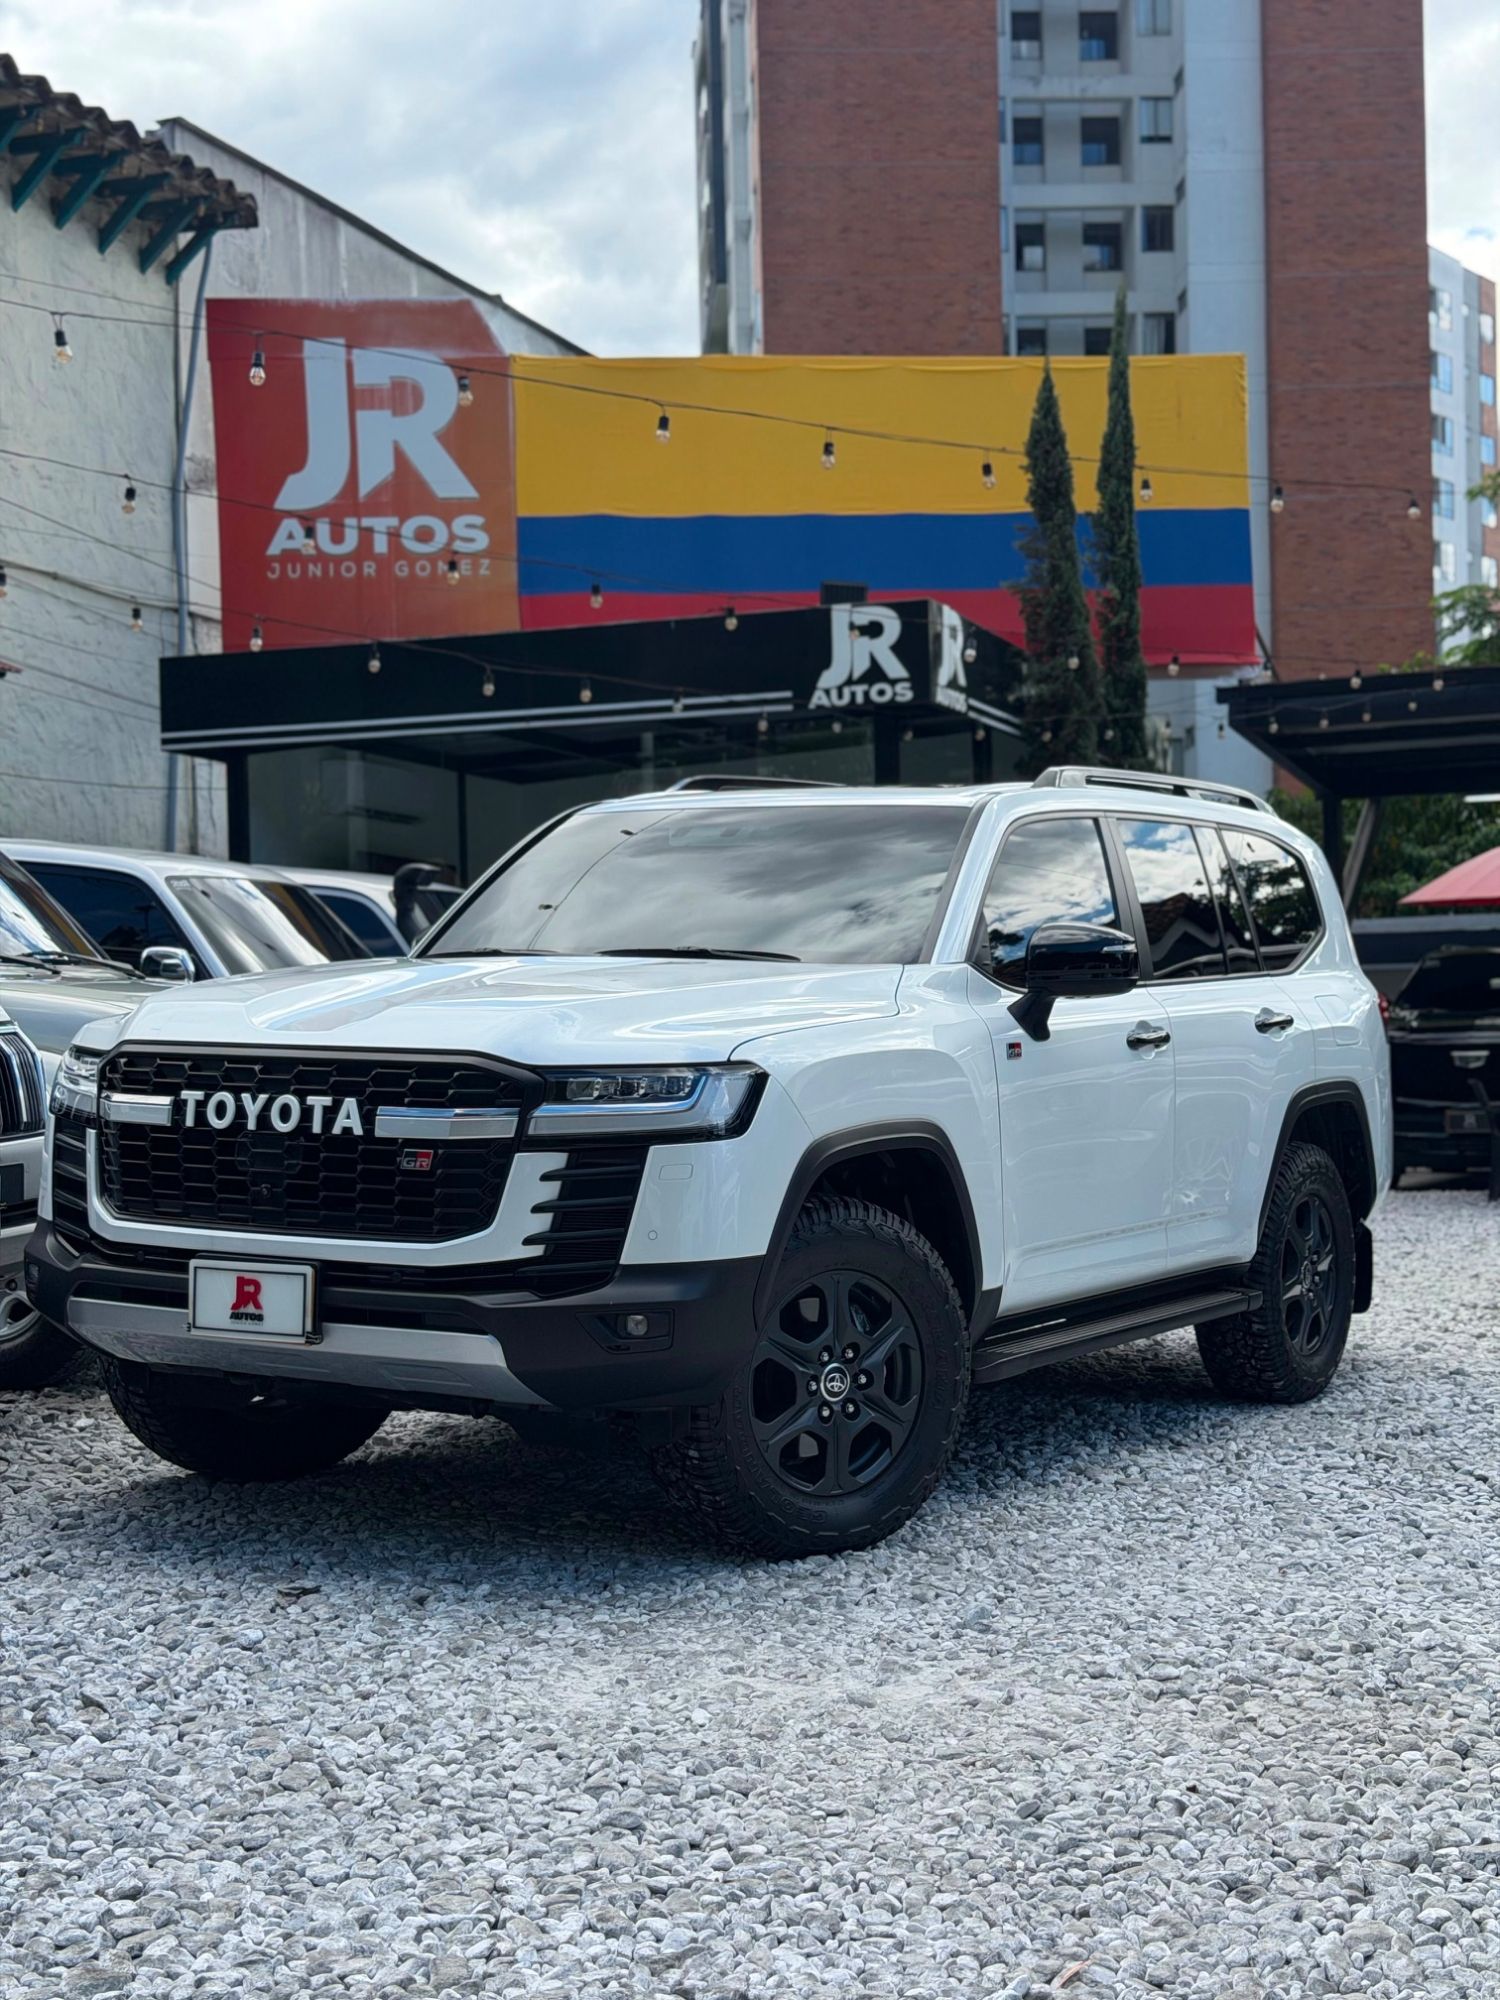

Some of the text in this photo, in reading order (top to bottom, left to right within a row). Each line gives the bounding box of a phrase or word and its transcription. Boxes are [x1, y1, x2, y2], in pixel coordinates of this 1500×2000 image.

[272, 336, 480, 512] JR
[265, 514, 490, 556] AUTOS
[266, 560, 377, 579] JUNIOR
[816, 603, 911, 690] JR
[808, 681, 915, 710] AUTOS
[180, 1089, 364, 1136] TOYOTA
[402, 1156, 431, 1169] GR
[230, 1275, 264, 1311] JR
[229, 1312, 264, 1322] AUTOS
